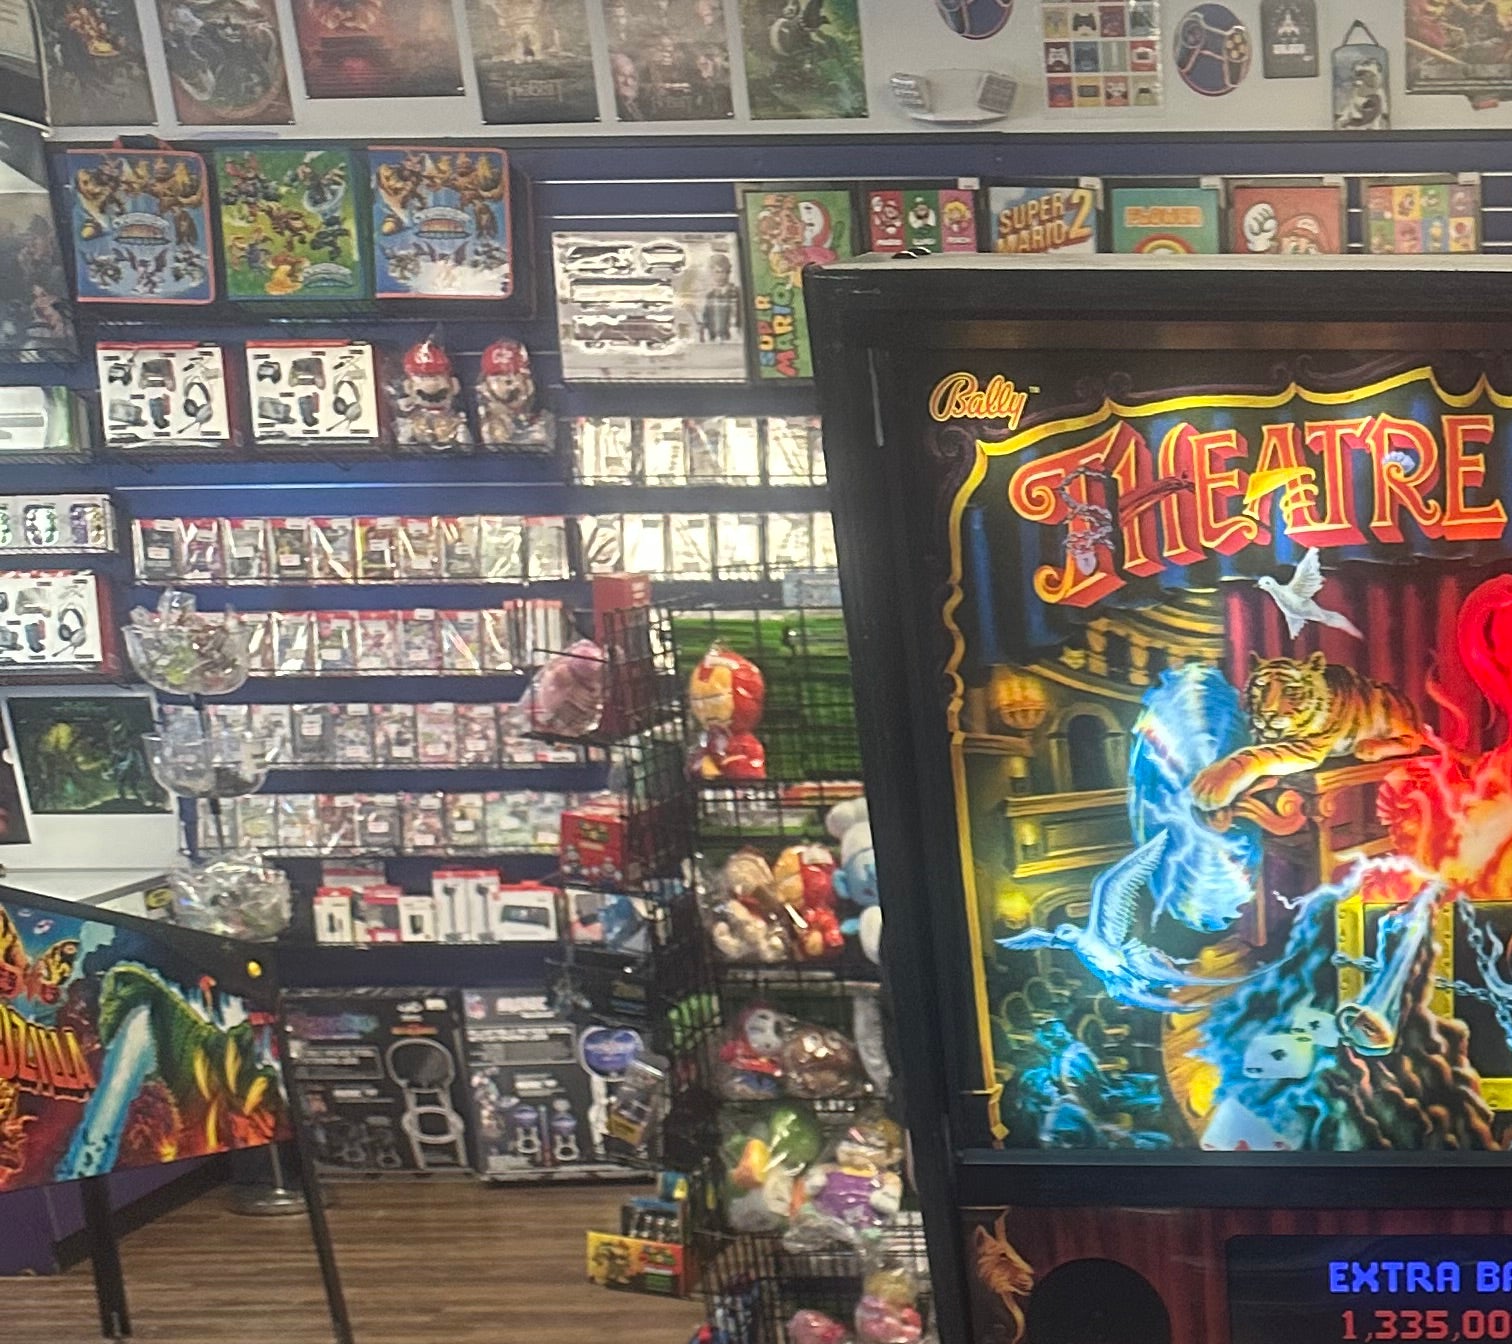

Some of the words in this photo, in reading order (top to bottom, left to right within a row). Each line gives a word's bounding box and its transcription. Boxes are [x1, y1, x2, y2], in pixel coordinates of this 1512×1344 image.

[1000, 191, 1064, 232] SUPER
[1069, 188, 1095, 239] 2
[929, 371, 1029, 430] Bally
[1009, 411, 1508, 608] THEATRE
[1328, 1260, 1460, 1292] EXTRA
